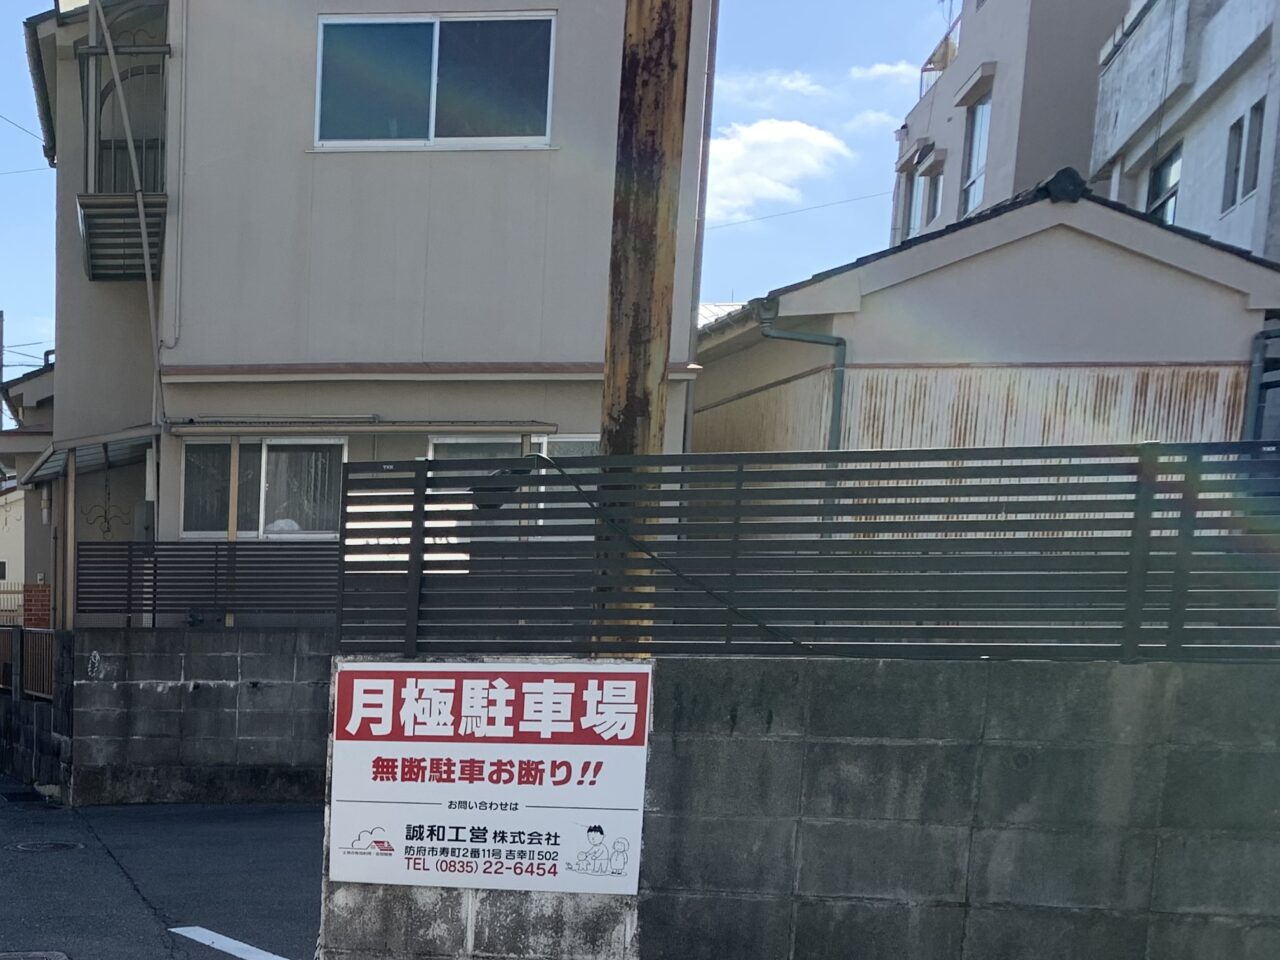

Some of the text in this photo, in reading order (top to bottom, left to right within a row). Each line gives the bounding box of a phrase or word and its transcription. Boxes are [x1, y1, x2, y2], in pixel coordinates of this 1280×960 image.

[345, 677, 639, 741] 月極駐車場
[371, 755, 604, 787] 無断駐車お断り!!
[447, 800, 520, 812] お問い合わせは
[405, 824, 561, 847] 誠和工営 株式会社
[404, 845, 502, 859] 防府市寿町2番11号
[404, 857, 559, 878] TEL (0835) 22-6454
